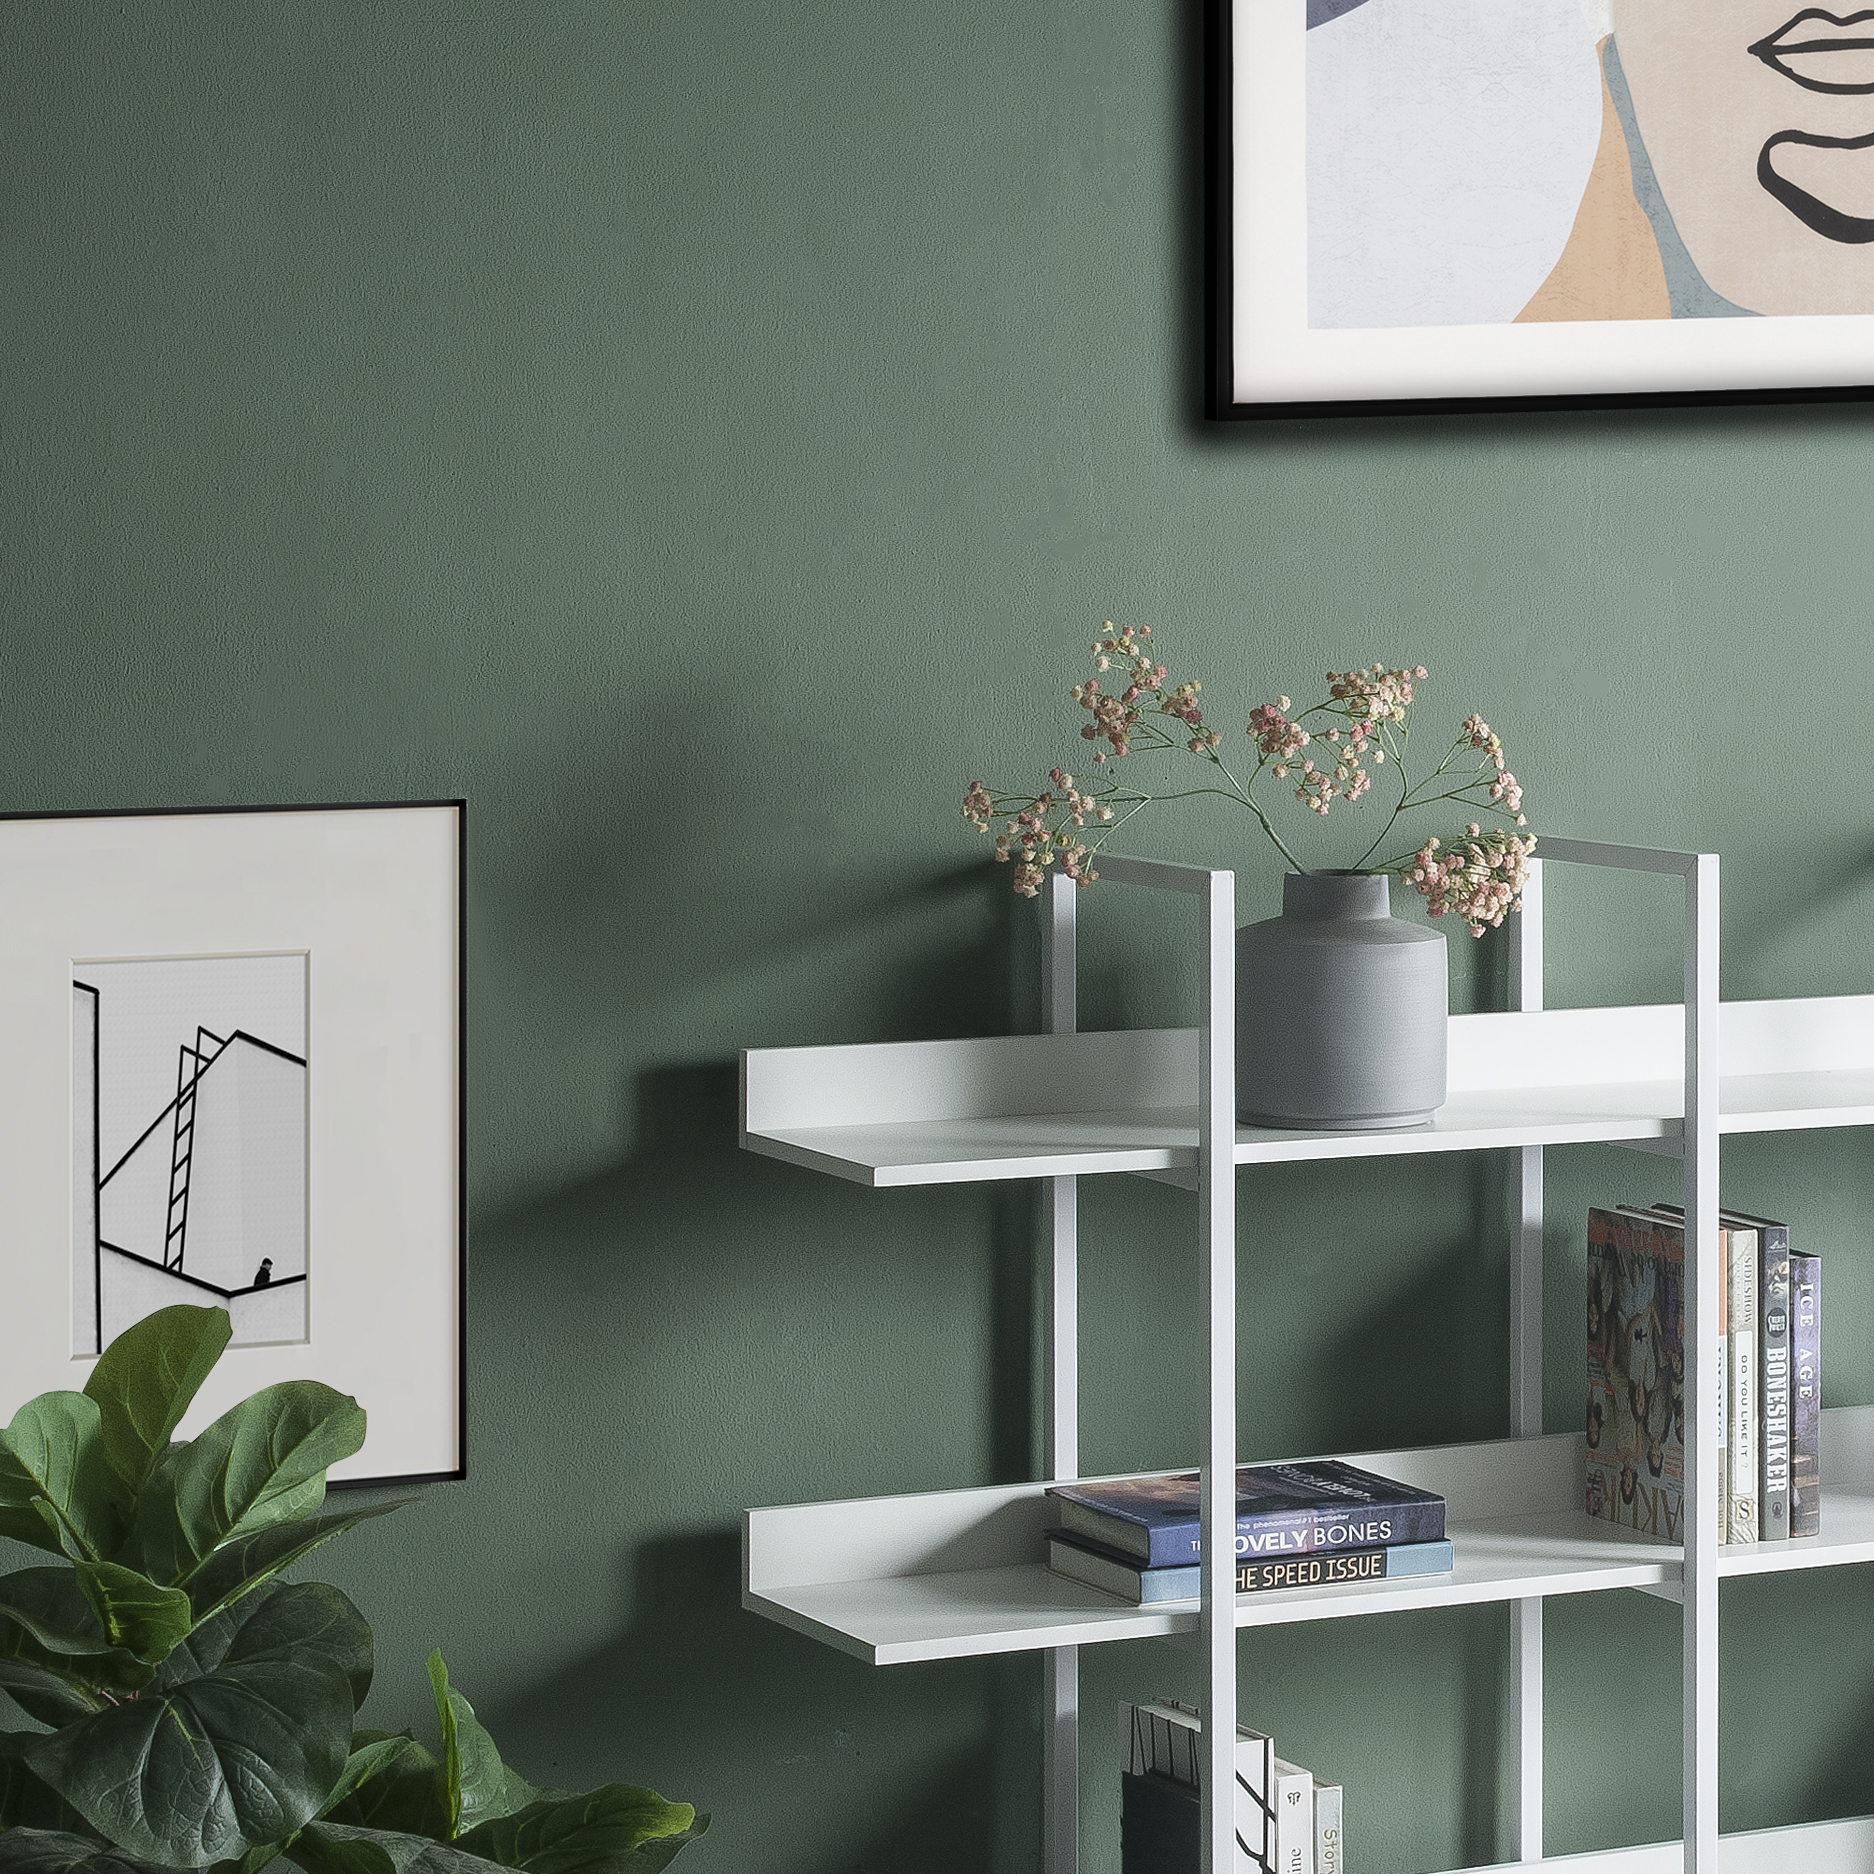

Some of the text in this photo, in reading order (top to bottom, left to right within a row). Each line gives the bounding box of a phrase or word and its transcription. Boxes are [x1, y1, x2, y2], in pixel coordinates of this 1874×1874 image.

[1744, 1257, 1753, 1323] SIDESHOW
[1799, 1283, 1814, 1399] ICE AGE
[1741, 1355, 1748, 1373] DO
[1740, 1381, 1748, 1406] YOU
[1767, 1346, 1787, 1494] BONESHAKER
[1235, 1521, 1392, 1553] OVELY BONES
[1236, 1555, 1382, 1589] HE SPEED ISSUE
